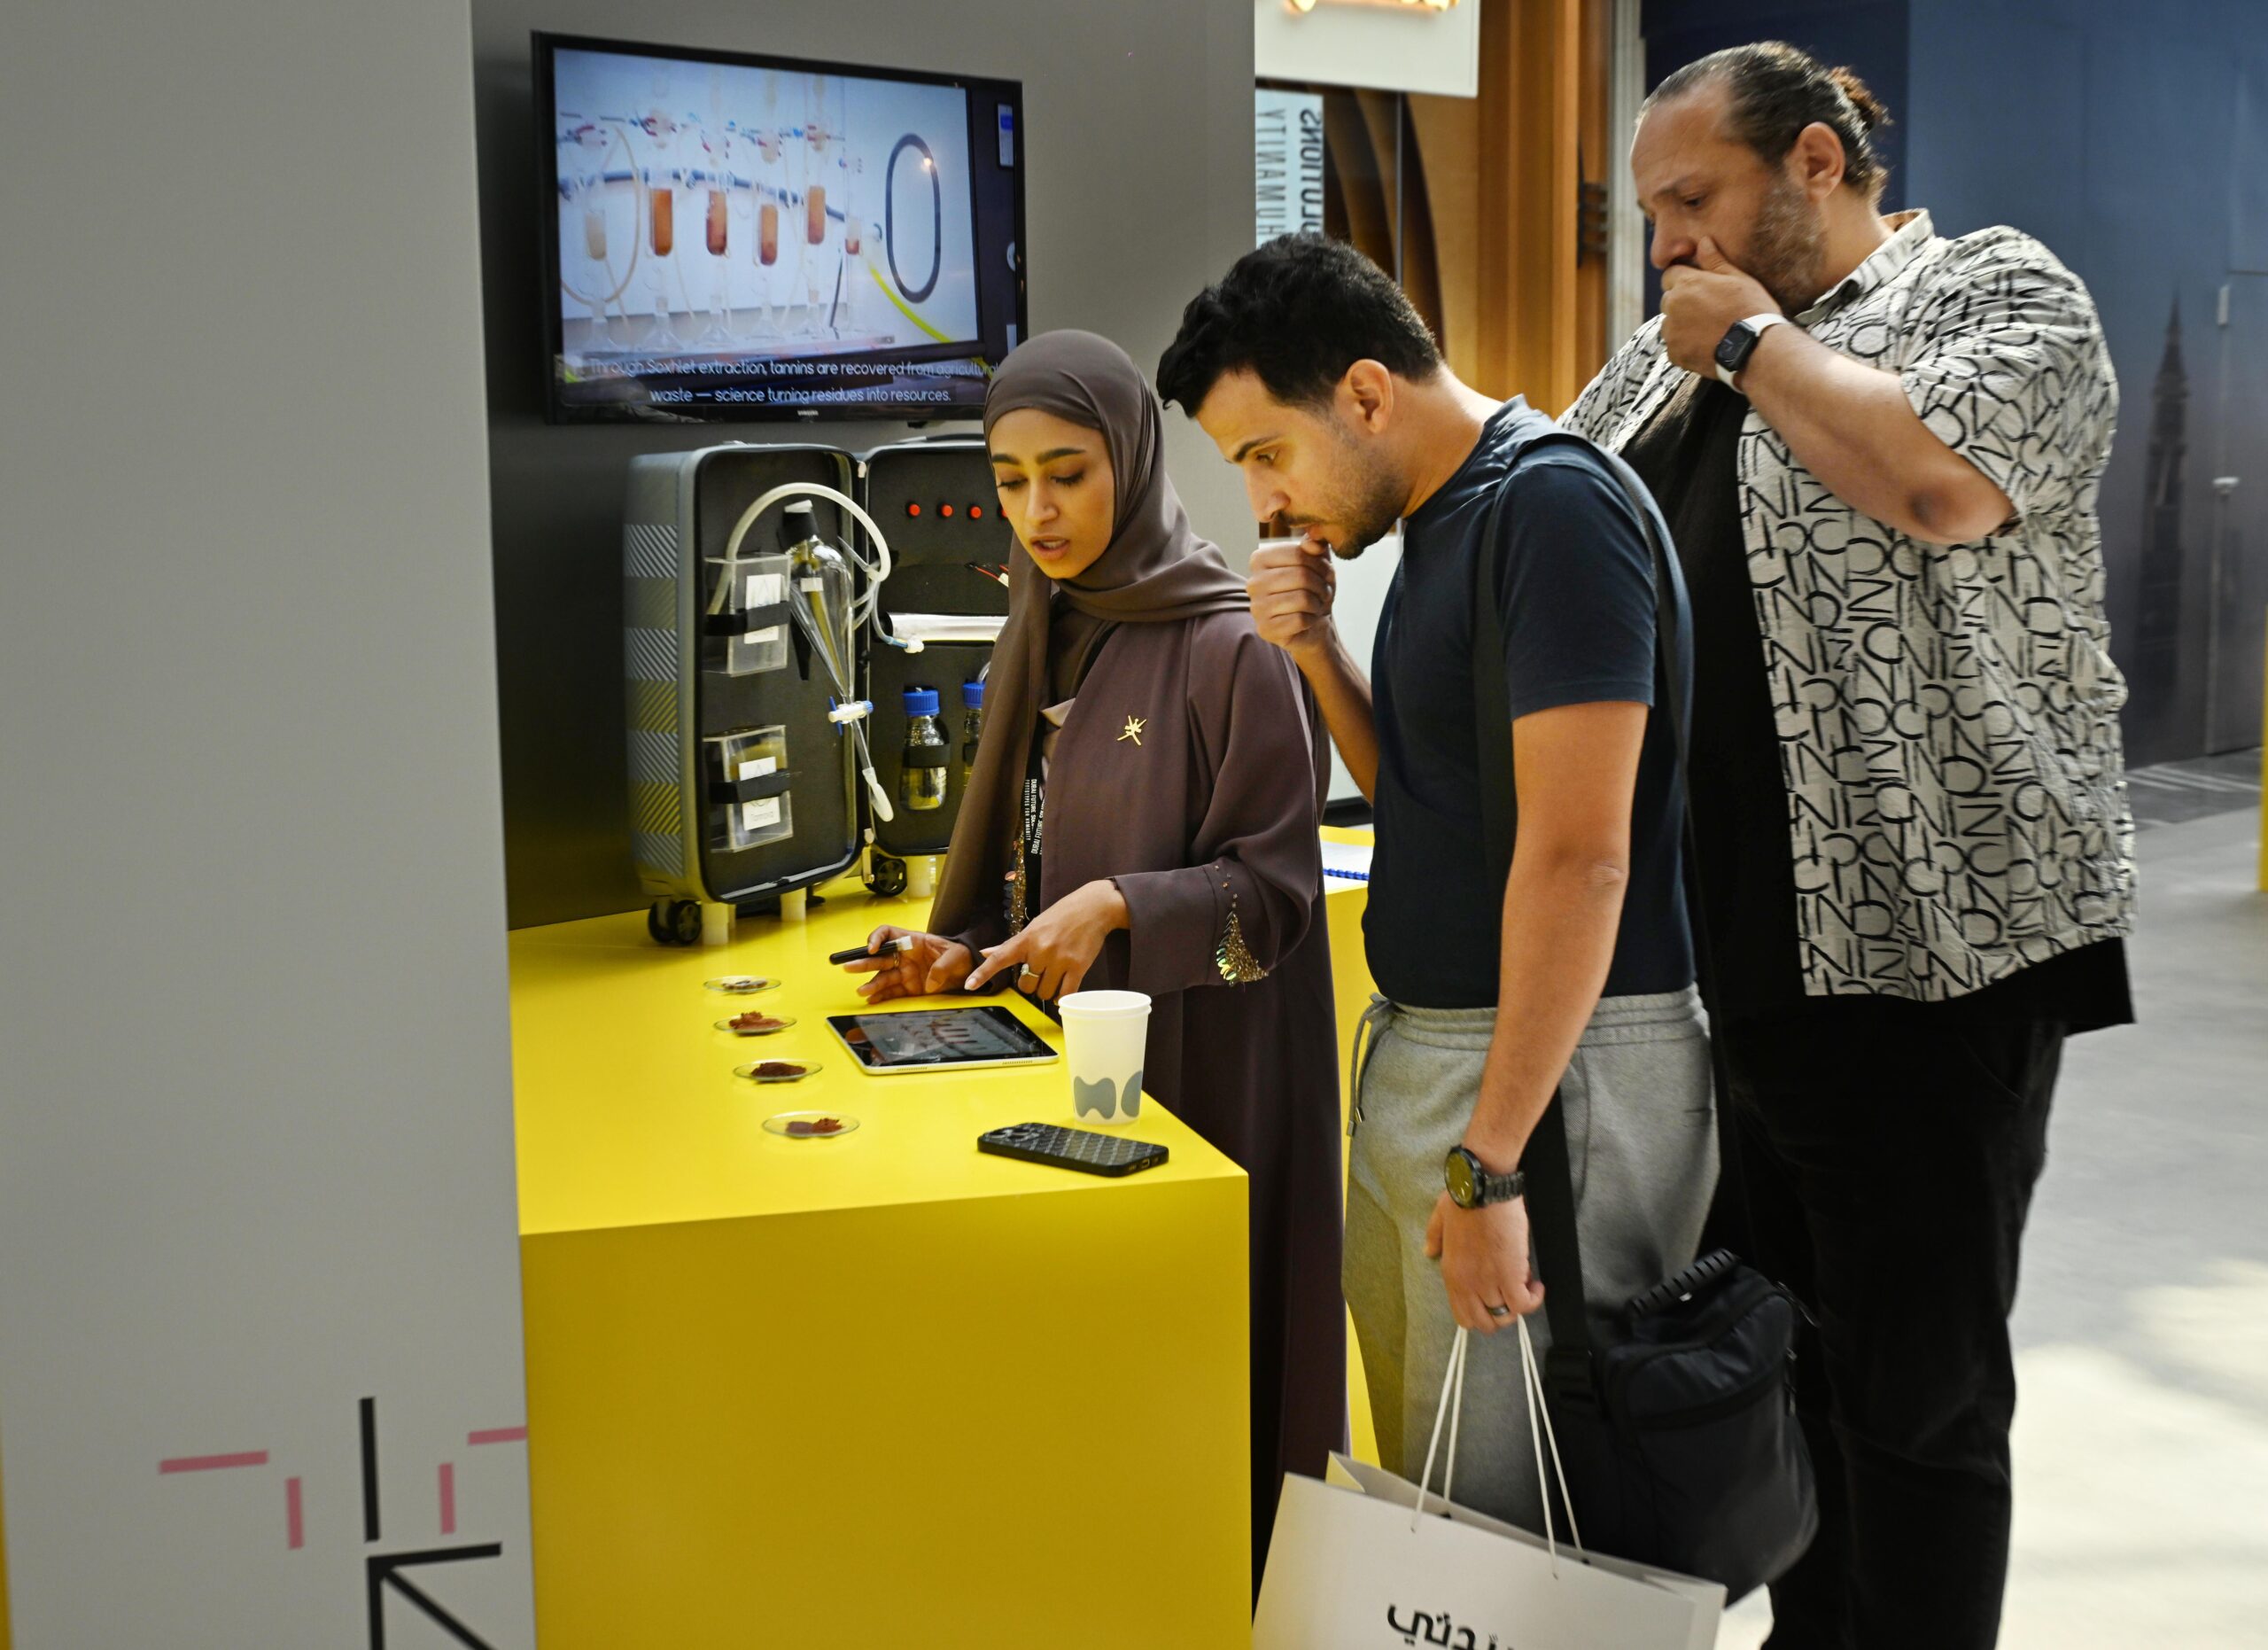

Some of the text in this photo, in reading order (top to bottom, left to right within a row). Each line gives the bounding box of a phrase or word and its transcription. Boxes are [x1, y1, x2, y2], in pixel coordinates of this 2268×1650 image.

[698, 359, 768, 377] extraction,
[770, 361, 814, 375] tannins
[817, 363, 838, 375] are
[841, 361, 905, 376] recovered
[906, 362, 934, 376] from
[649, 386, 693, 402] waste
[715, 387, 765, 402] science
[767, 387, 810, 404] turning
[812, 387, 864, 401] residues
[866, 387, 888, 401] into
[891, 390, 951, 401] resources.
